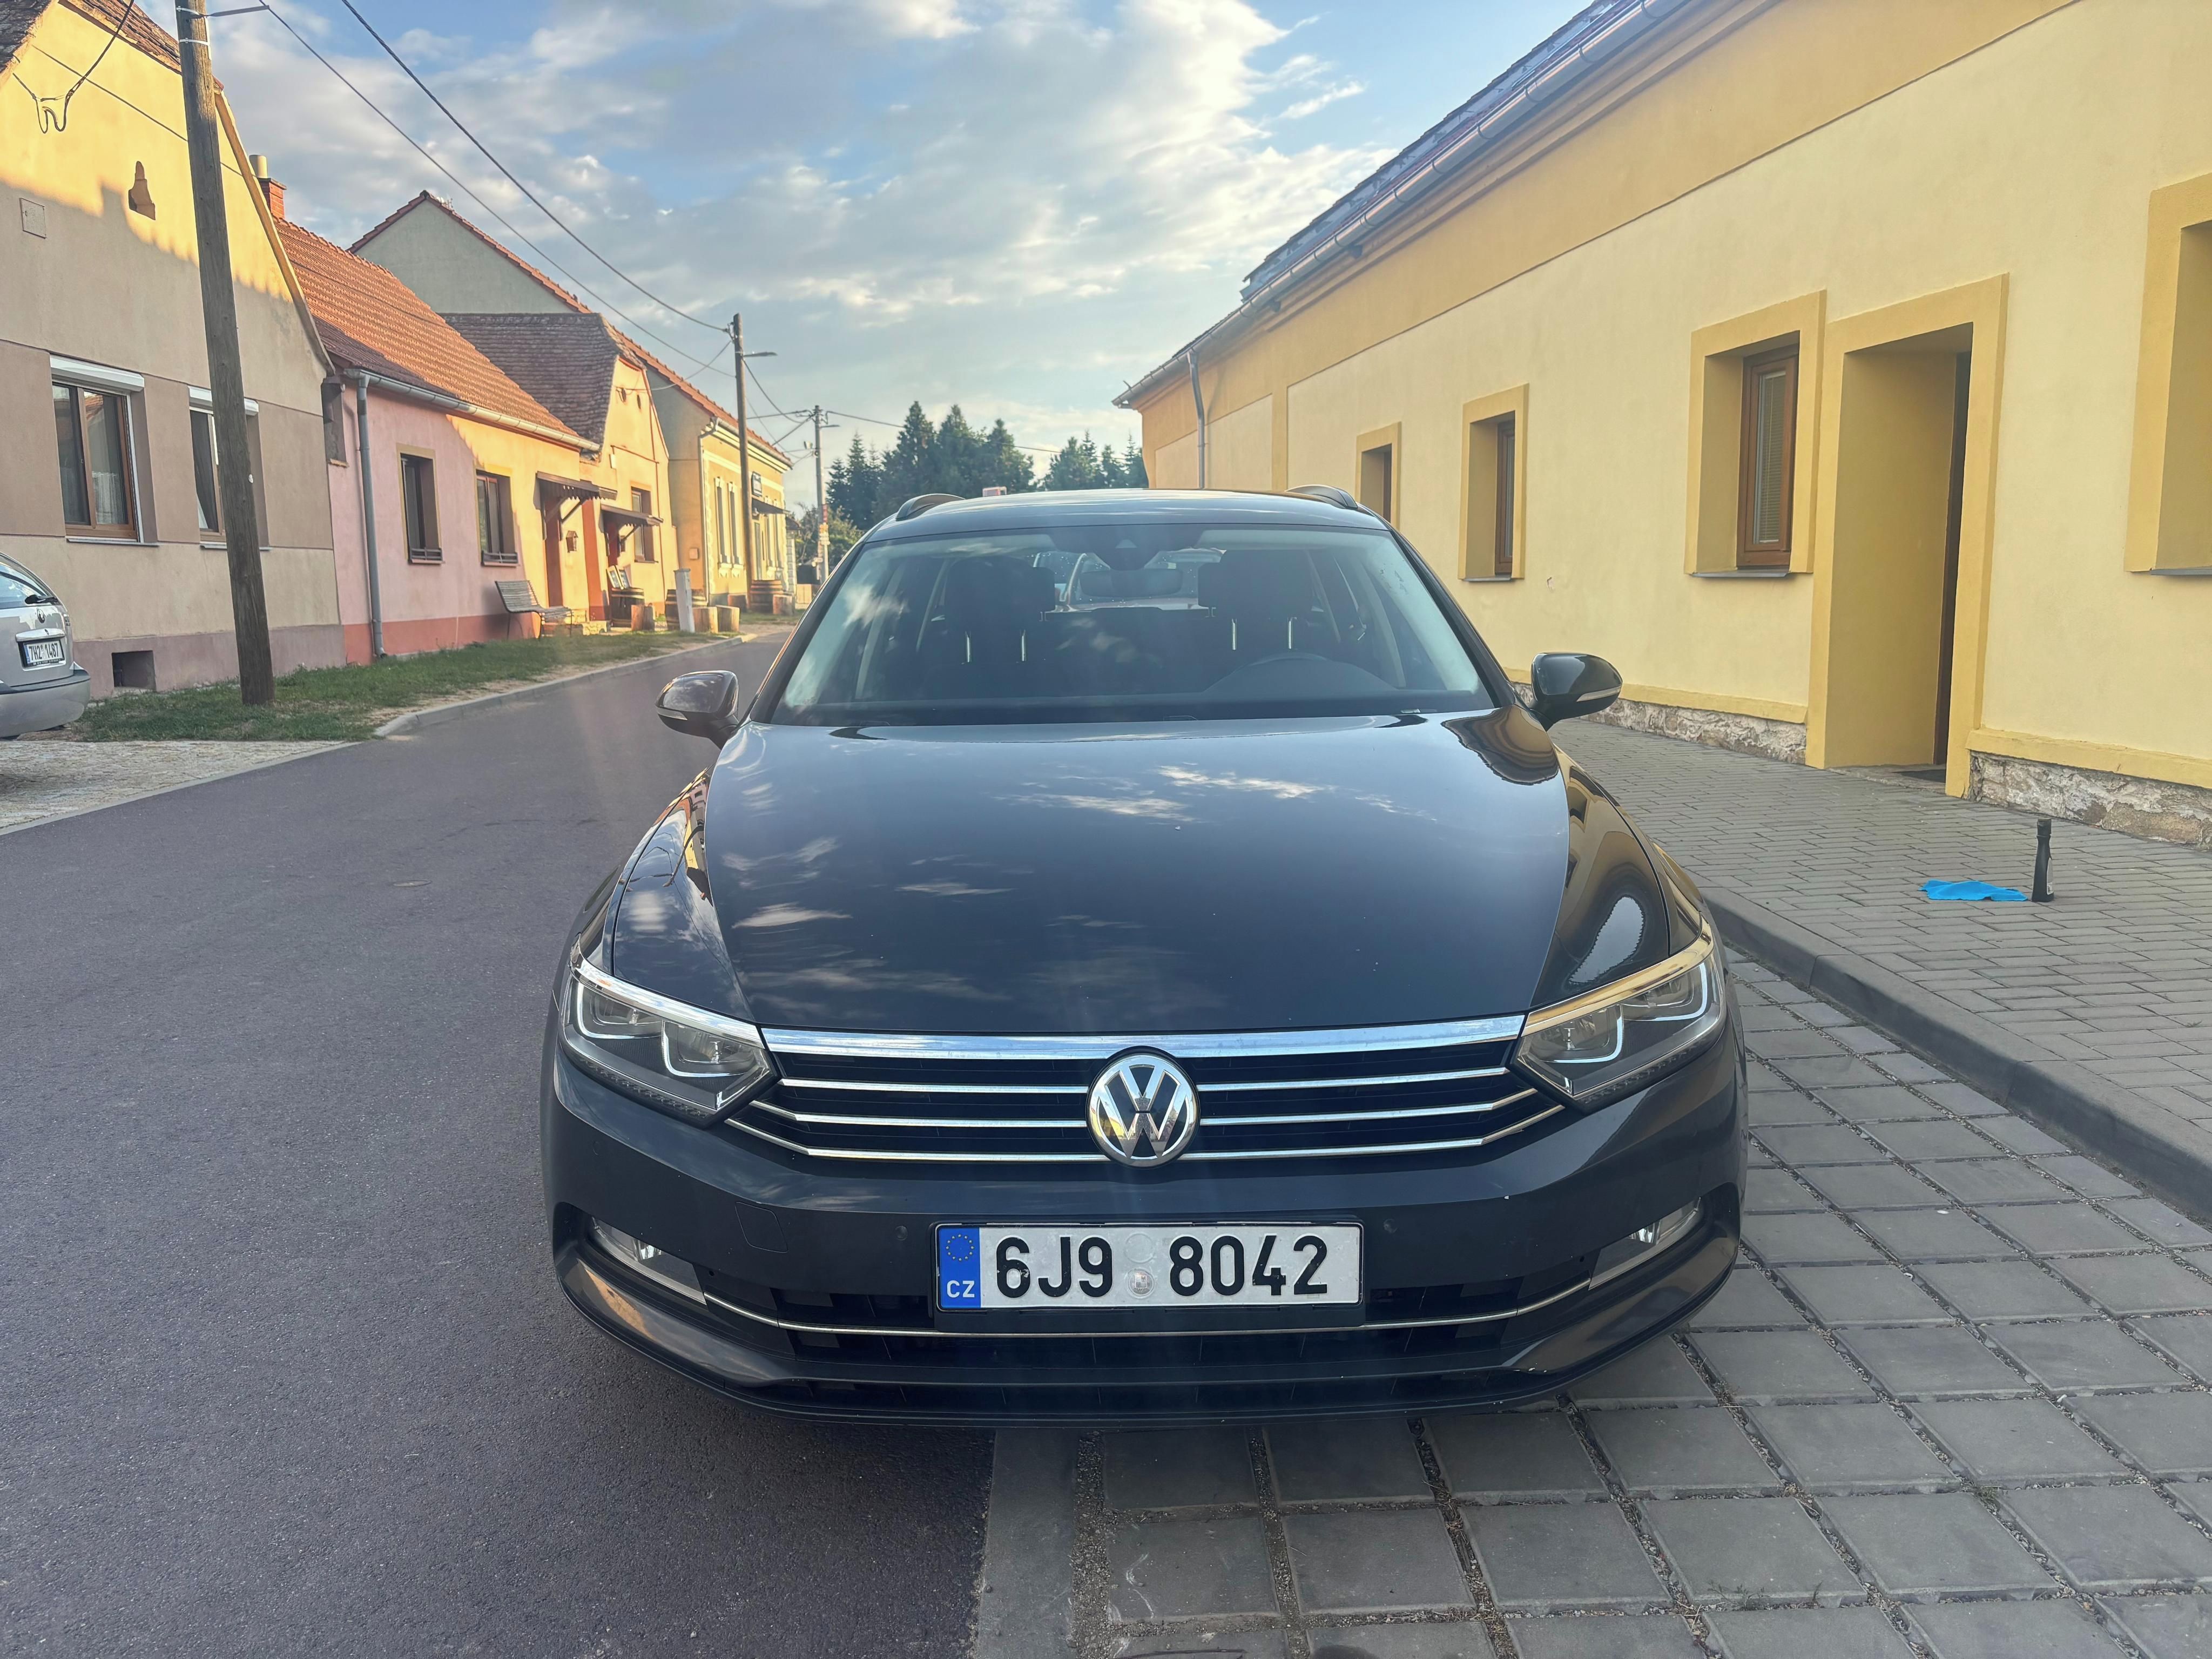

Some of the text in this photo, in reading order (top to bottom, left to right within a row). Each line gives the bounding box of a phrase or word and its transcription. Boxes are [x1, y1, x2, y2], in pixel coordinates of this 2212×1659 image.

[29, 643, 59, 660] 7H2 1487
[1090, 1055, 1196, 1165] VW
[996, 1235, 1328, 1298] 6J9 8042
[947, 1280, 975, 1298] CZ
